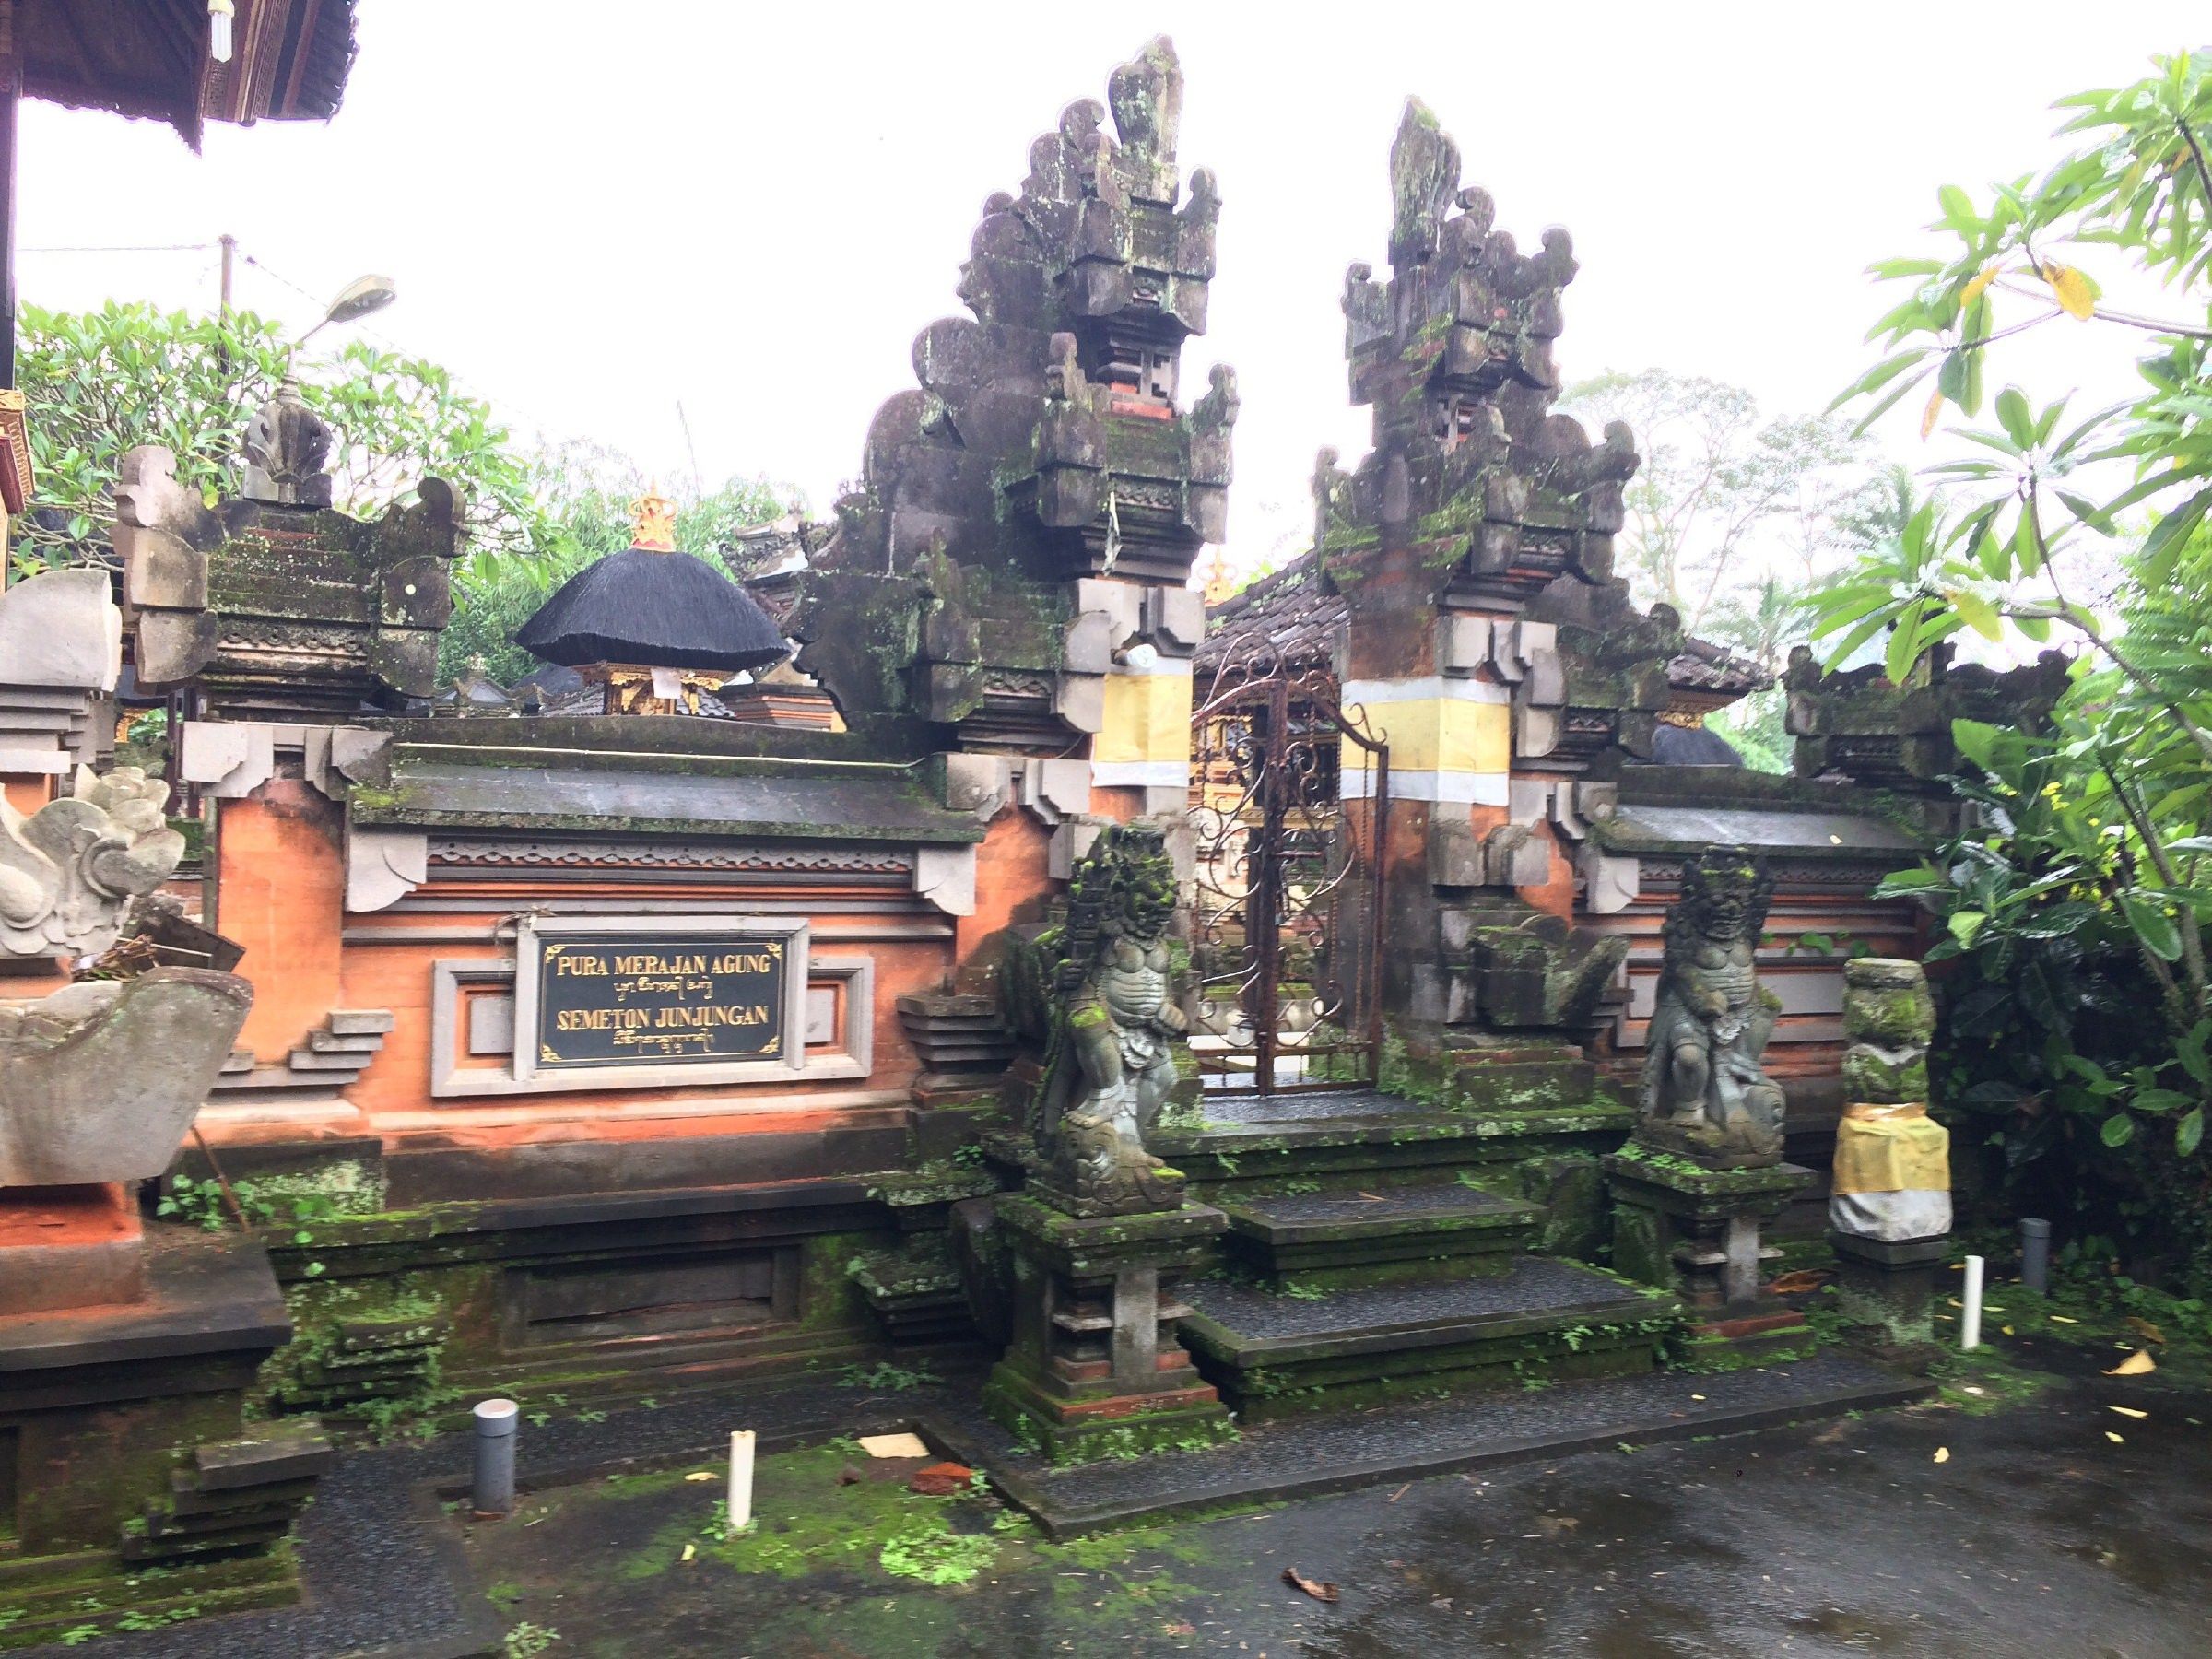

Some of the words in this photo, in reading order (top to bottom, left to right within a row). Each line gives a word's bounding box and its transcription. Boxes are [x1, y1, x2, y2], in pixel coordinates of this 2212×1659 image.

[557, 956, 610, 976] PURA
[614, 955, 708, 975] MERAJAN
[711, 954, 771, 974] AGUNG
[557, 1008, 651, 1030] SEMETON
[654, 1006, 769, 1029] JUNJUNGAN
